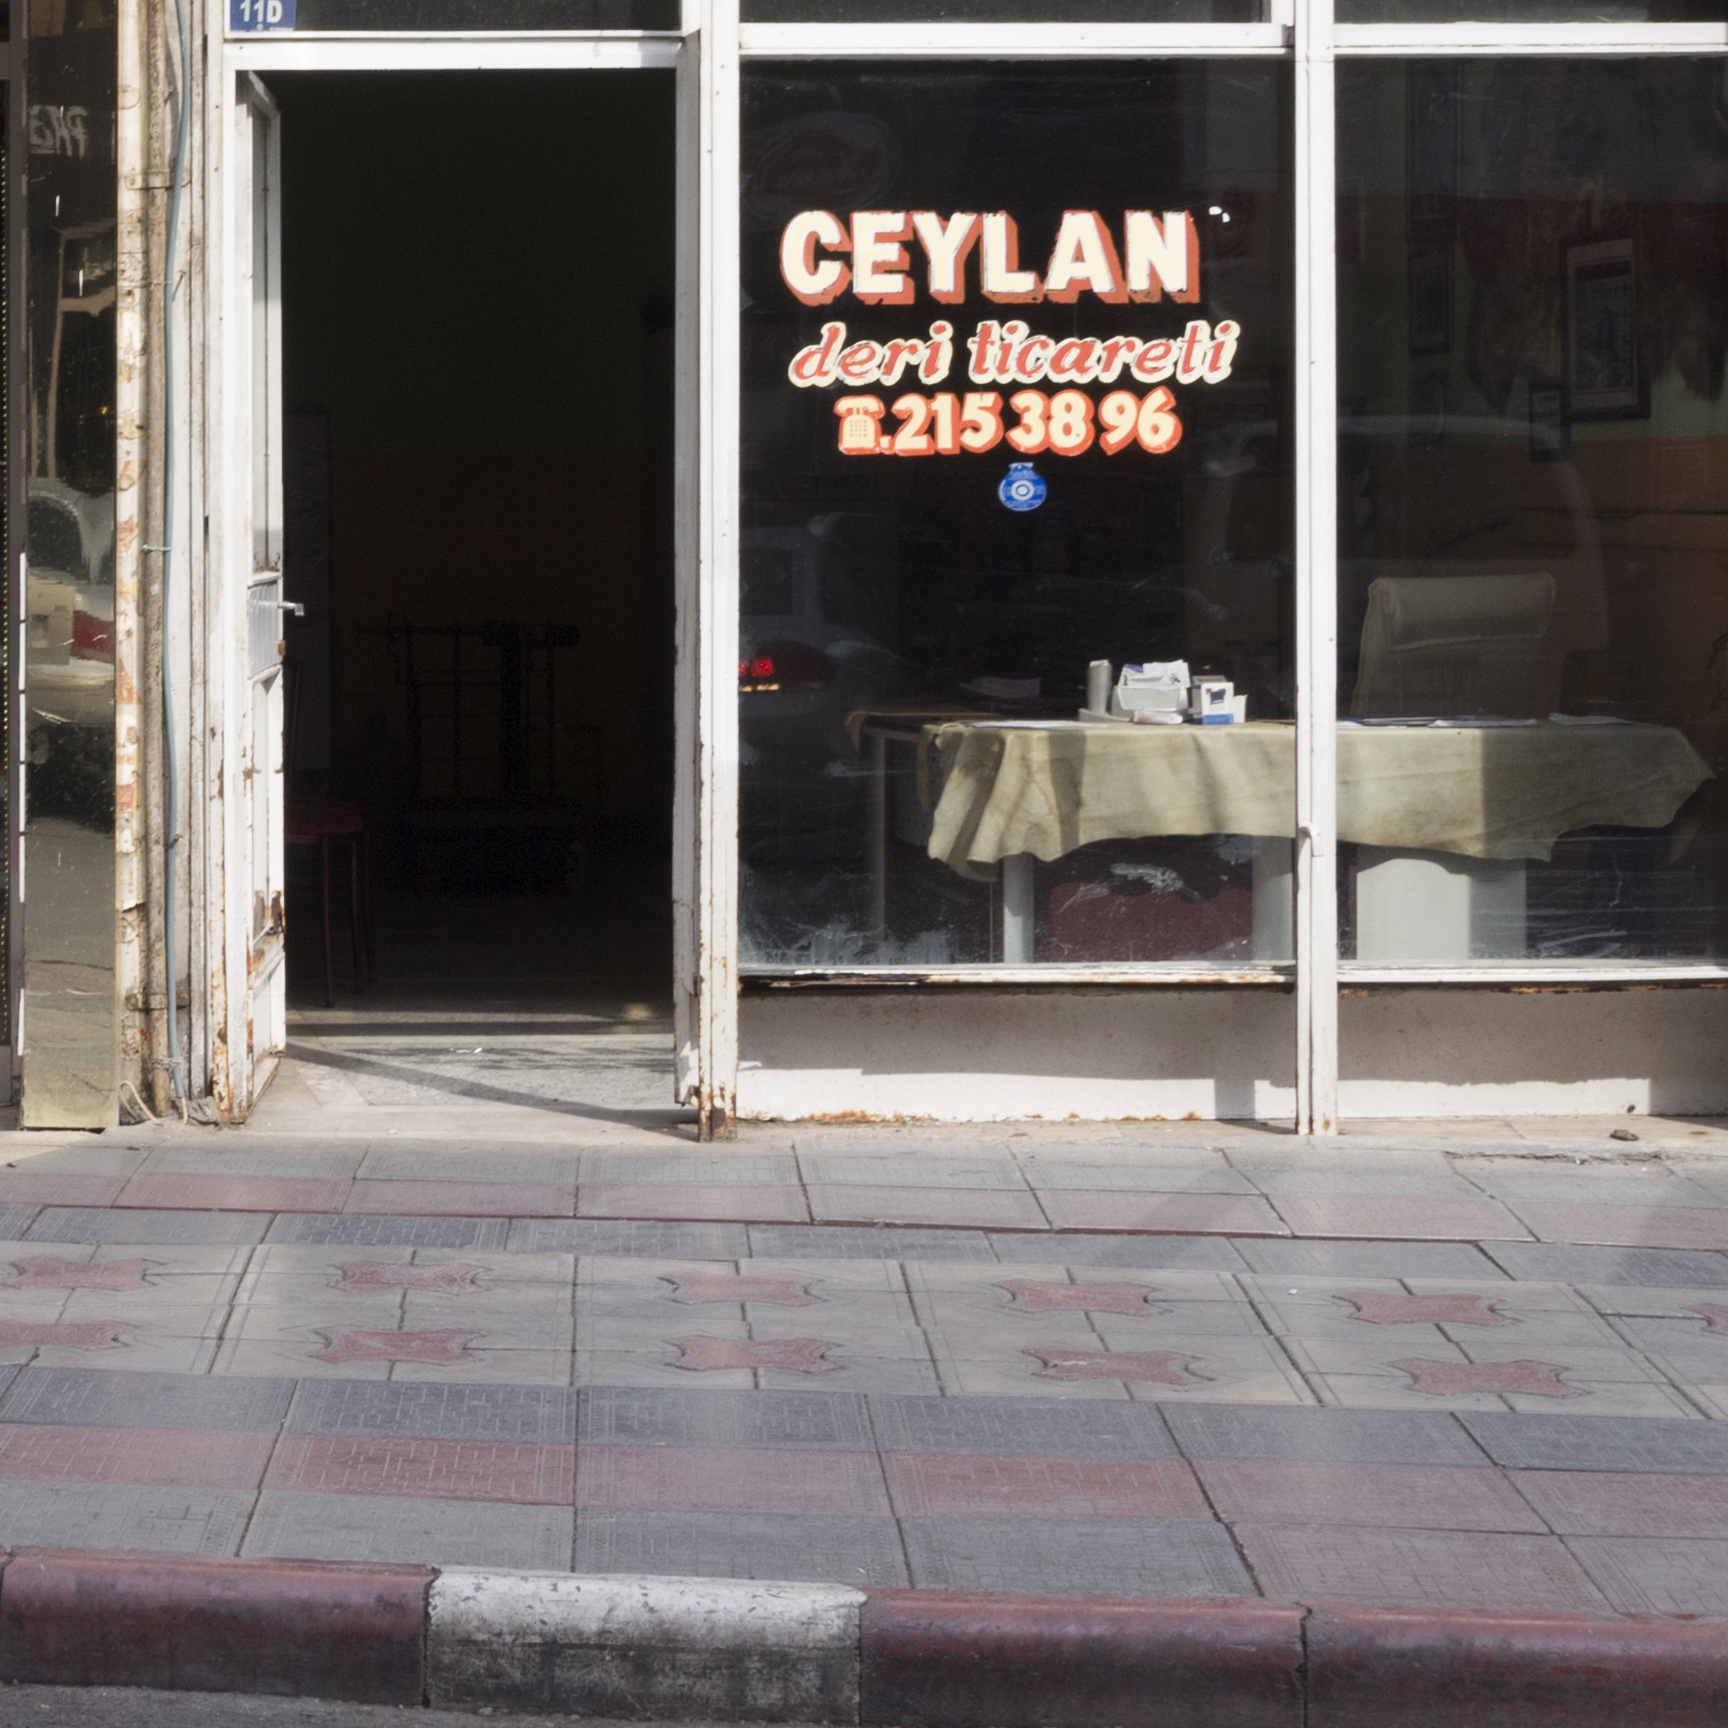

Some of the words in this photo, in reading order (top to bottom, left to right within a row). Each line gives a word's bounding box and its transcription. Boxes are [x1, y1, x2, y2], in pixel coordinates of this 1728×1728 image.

[779, 209, 1200, 306] CEYLAN
[789, 320, 954, 388] deri
[968, 320, 1241, 385] ticareti
